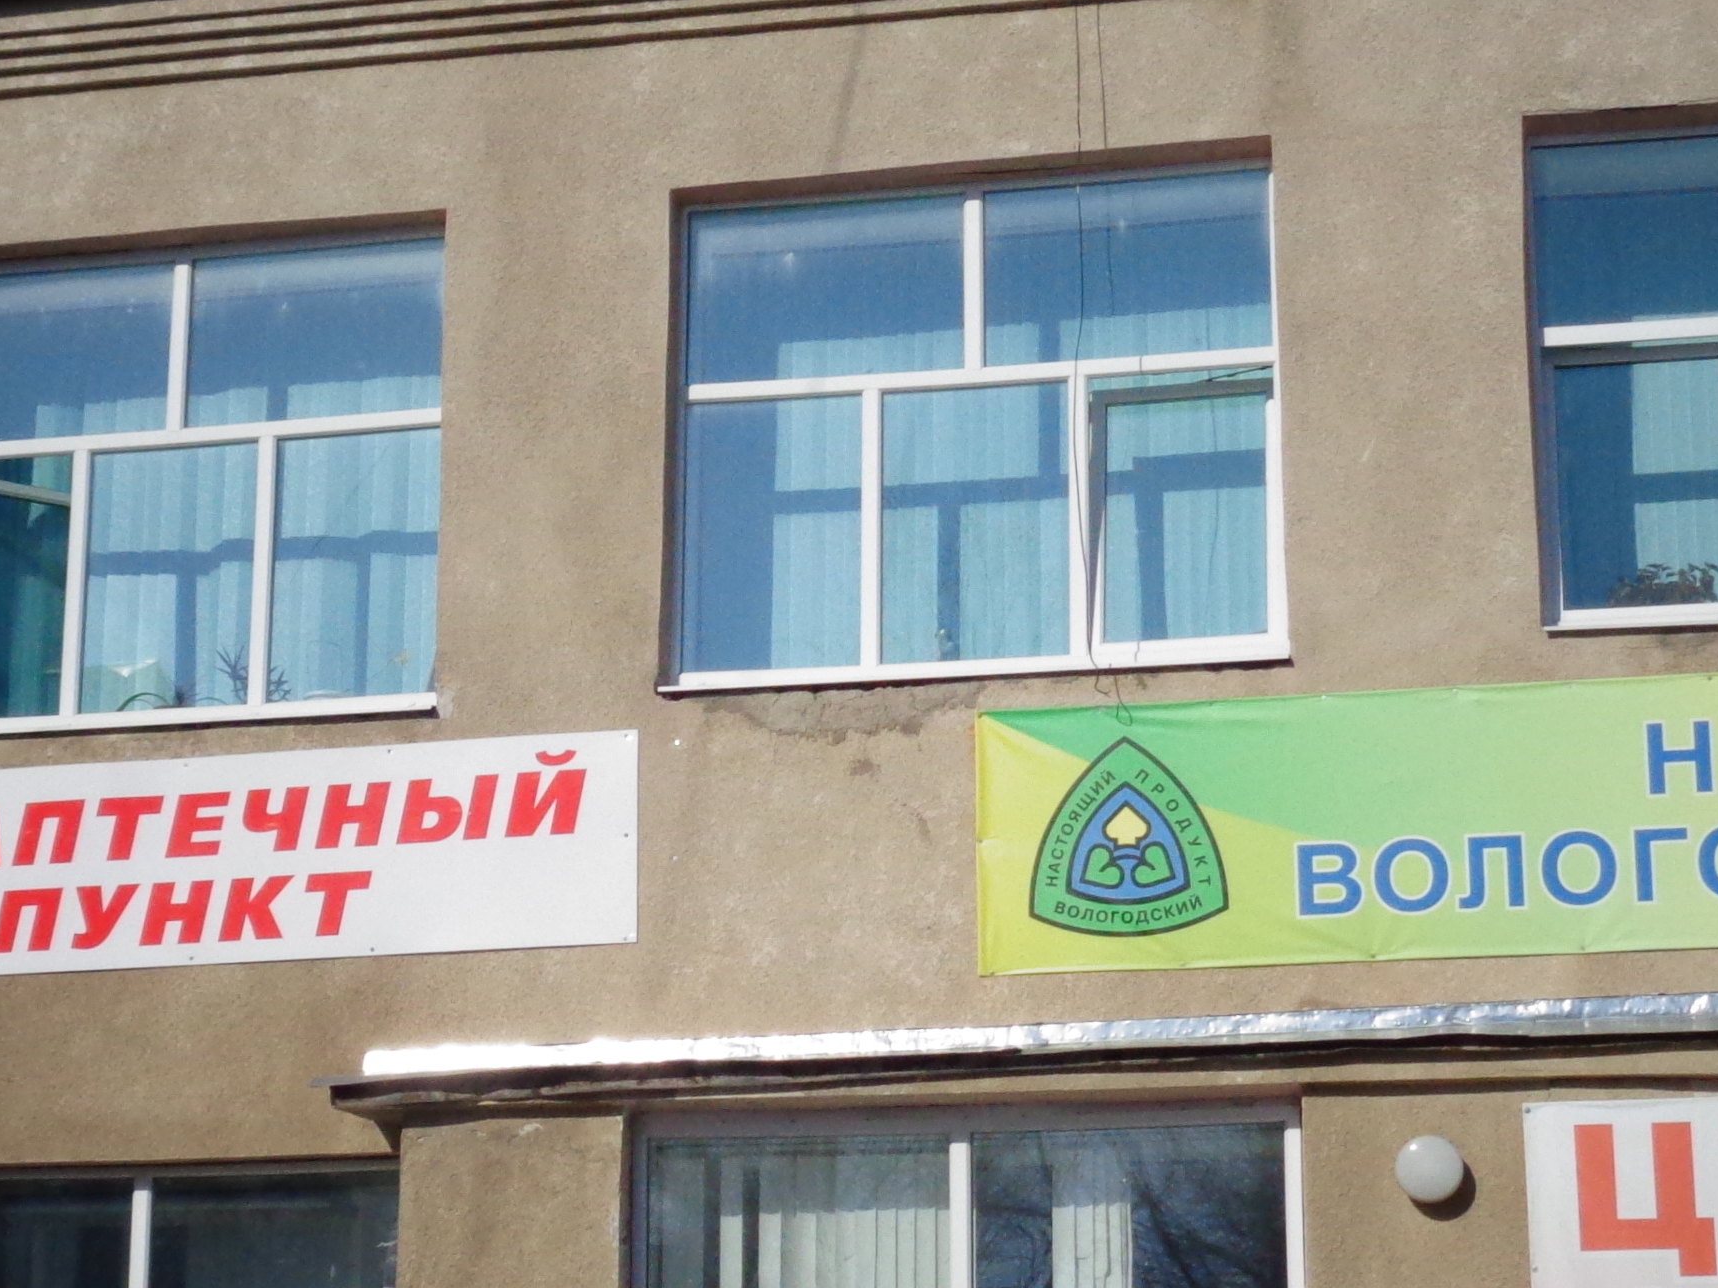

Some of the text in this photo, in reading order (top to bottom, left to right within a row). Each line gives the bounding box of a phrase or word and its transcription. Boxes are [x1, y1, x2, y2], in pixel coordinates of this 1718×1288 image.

[1045, 768, 1212, 888] НАСТОЯЩИЙ ПРОДУКТ
[1053, 893, 1204, 926] ВОЛОГОДСКИЙ
